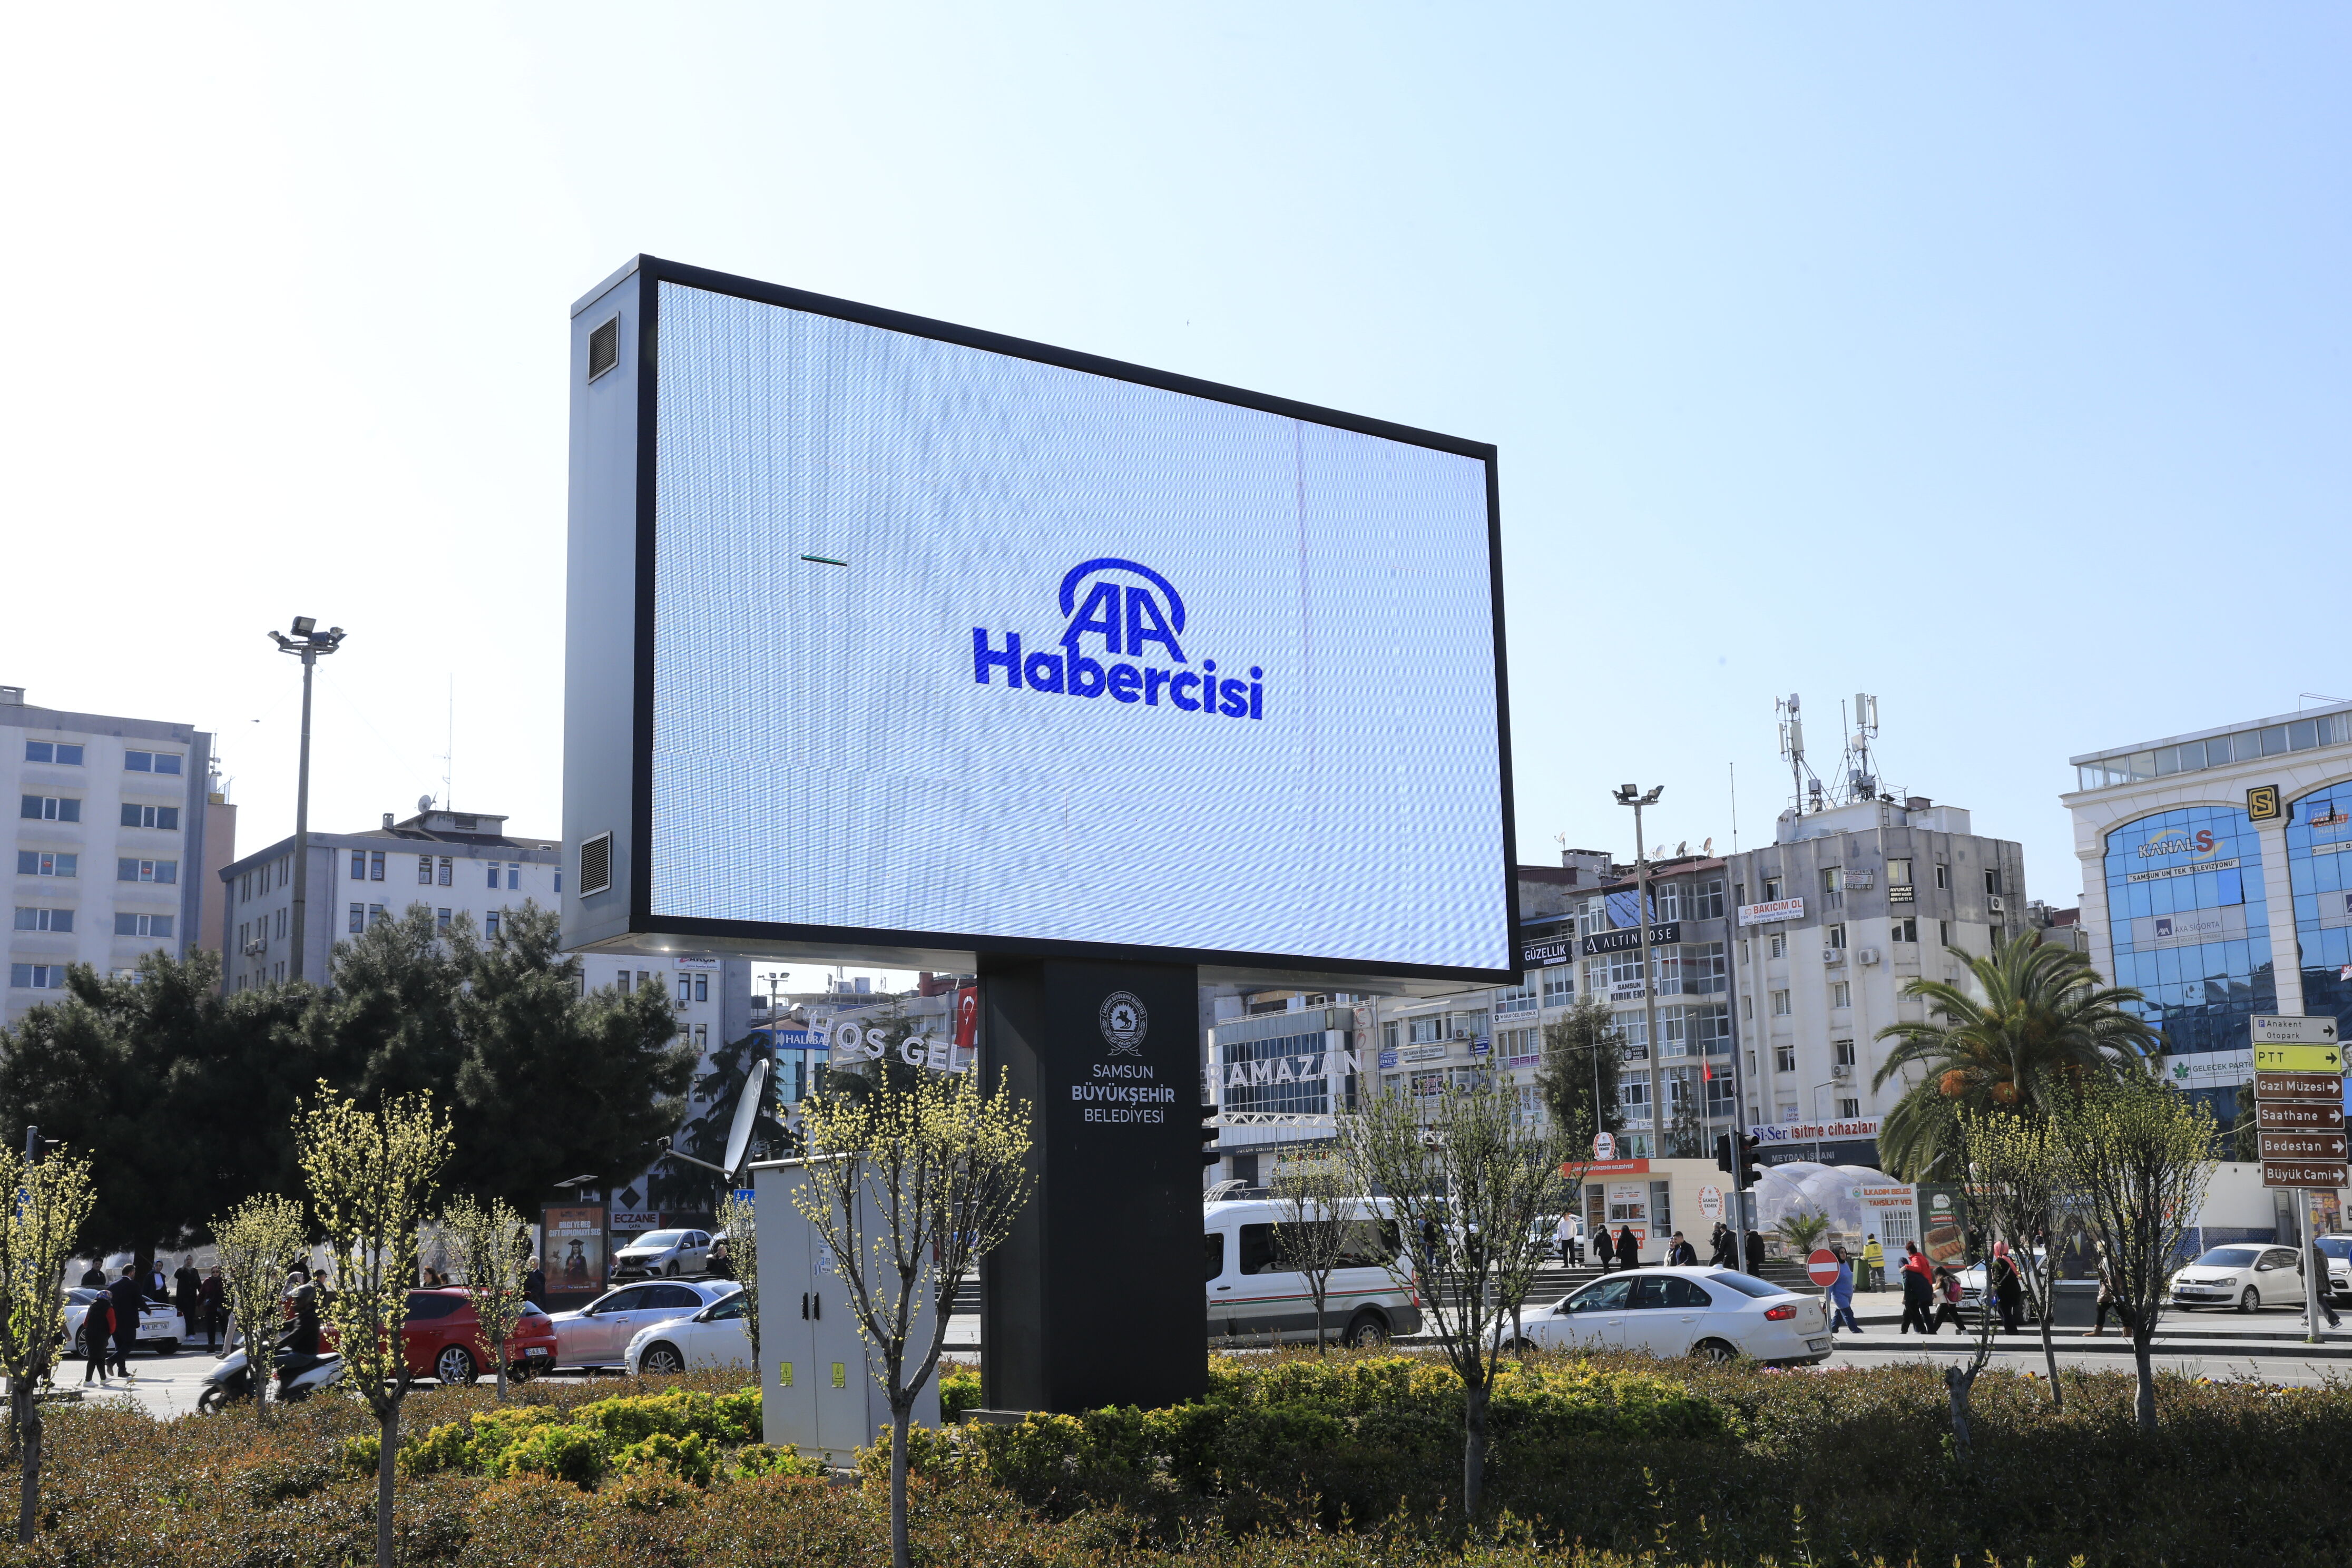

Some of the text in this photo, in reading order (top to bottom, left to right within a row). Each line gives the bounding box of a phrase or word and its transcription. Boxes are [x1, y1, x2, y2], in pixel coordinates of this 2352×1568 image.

[973, 627, 1262, 720] Habercisi
[2315, 809, 2344, 818] SAMSN
[2319, 824, 2346, 834] HABER
[2138, 837, 2196, 858] KANAL
[1753, 899, 1802, 914] BAKICIM OL
[2189, 920, 2220, 932] SİGORTA
[1604, 928, 1672, 948] ALTINÖŞE
[1525, 943, 1566, 962] GÜZELLİK
[1618, 982, 1641, 991] SAMSUN
[1610, 991, 1632, 1002] KIRIK
[1102, 999, 1113, 1014] SAMSUN
[2267, 1032, 2300, 1040] Otopark
[807, 1013, 977, 1073] HOŞ GEL
[2258, 1052, 2284, 1063] PTT
[1093, 1064, 1153, 1079] SAMSUN
[1206, 1049, 1363, 1089] RAMAZAN
[2192, 1063, 2227, 1072] GELECEK
[2259, 1080, 2325, 1092] Gazi Müzesi
[1072, 1082, 1175, 1105] BÜYÜKŞEHİR
[1084, 1106, 1164, 1123] BELEDİYESİ
[2261, 1109, 2318, 1121] Saathane
[1753, 1120, 1877, 1141] Si-Ser işitme cihazları
[2265, 1140, 2321, 1151] Bedestan
[1771, 1152, 1805, 1162] MEYDAN
[2267, 1168, 2331, 1181] Büyük Cami
[1863, 1188, 1890, 1196] İLKADIM
[1869, 1198, 1899, 1207] TAHSİLAT
[614, 1214, 656, 1223] ECZANE
